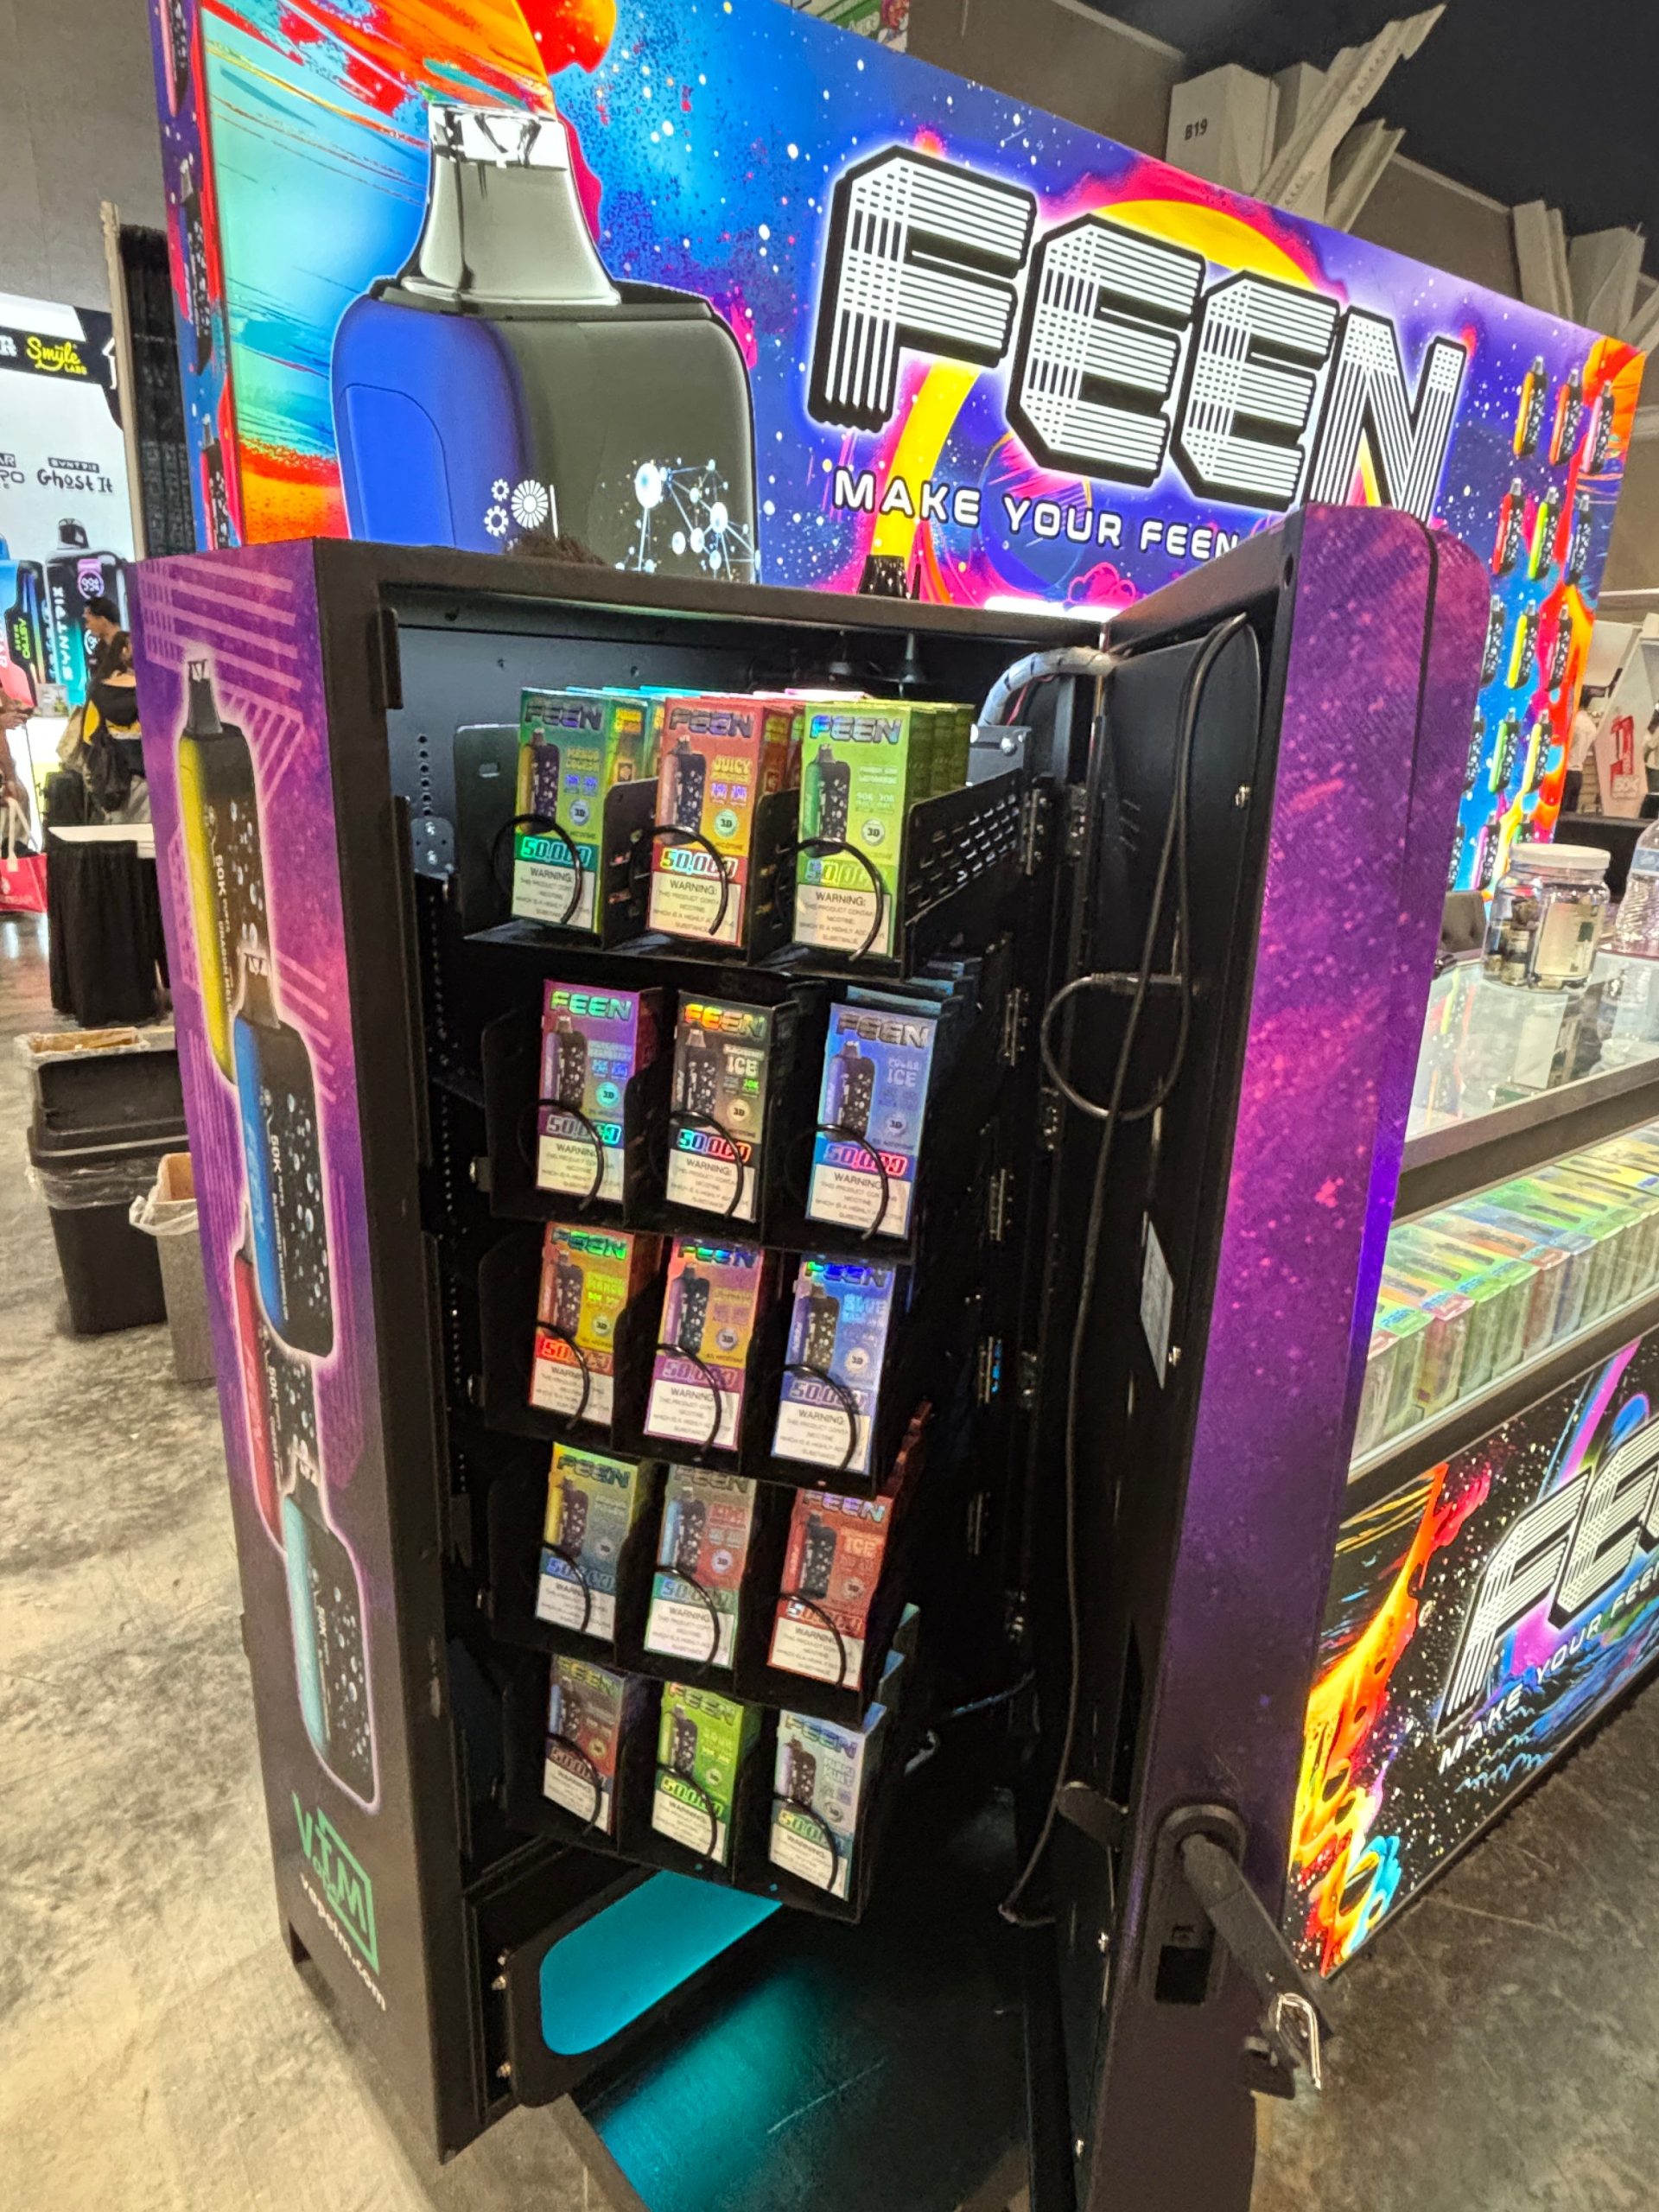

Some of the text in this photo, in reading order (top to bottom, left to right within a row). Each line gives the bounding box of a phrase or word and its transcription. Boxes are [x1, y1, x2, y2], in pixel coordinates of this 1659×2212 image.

[1185, 118, 1208, 141] B19
[806, 144, 1469, 518] FEEN
[37, 467, 113, 493] Ghost It
[833, 468, 1242, 560] MAKE YOUR FEEN
[524, 703, 603, 731] FEEN
[669, 707, 755, 739] FEEN
[810, 715, 901, 745] FEEN
[816, 891, 867, 906] WARNING:
[550, 990, 632, 1022] FEEN
[684, 1002, 766, 1037] FEEN
[837, 1014, 929, 1048] FEEN
[726, 1055, 760, 1077] ICE
[887, 1069, 917, 1088] ICE
[552, 1227, 628, 1260] FEEN
[677, 1240, 760, 1268] FEEN
[804, 1259, 891, 1288] FEEN
[558, 1455, 631, 1489] FEEN
[674, 1465, 749, 1495] FEEN
[803, 1490, 886, 1522] FEEN
[1436, 1415, 1659, 1733] FE
[1438, 1565, 1659, 1775] MAKE YOUR FEE
[669, 1682, 734, 1726] FEEN
